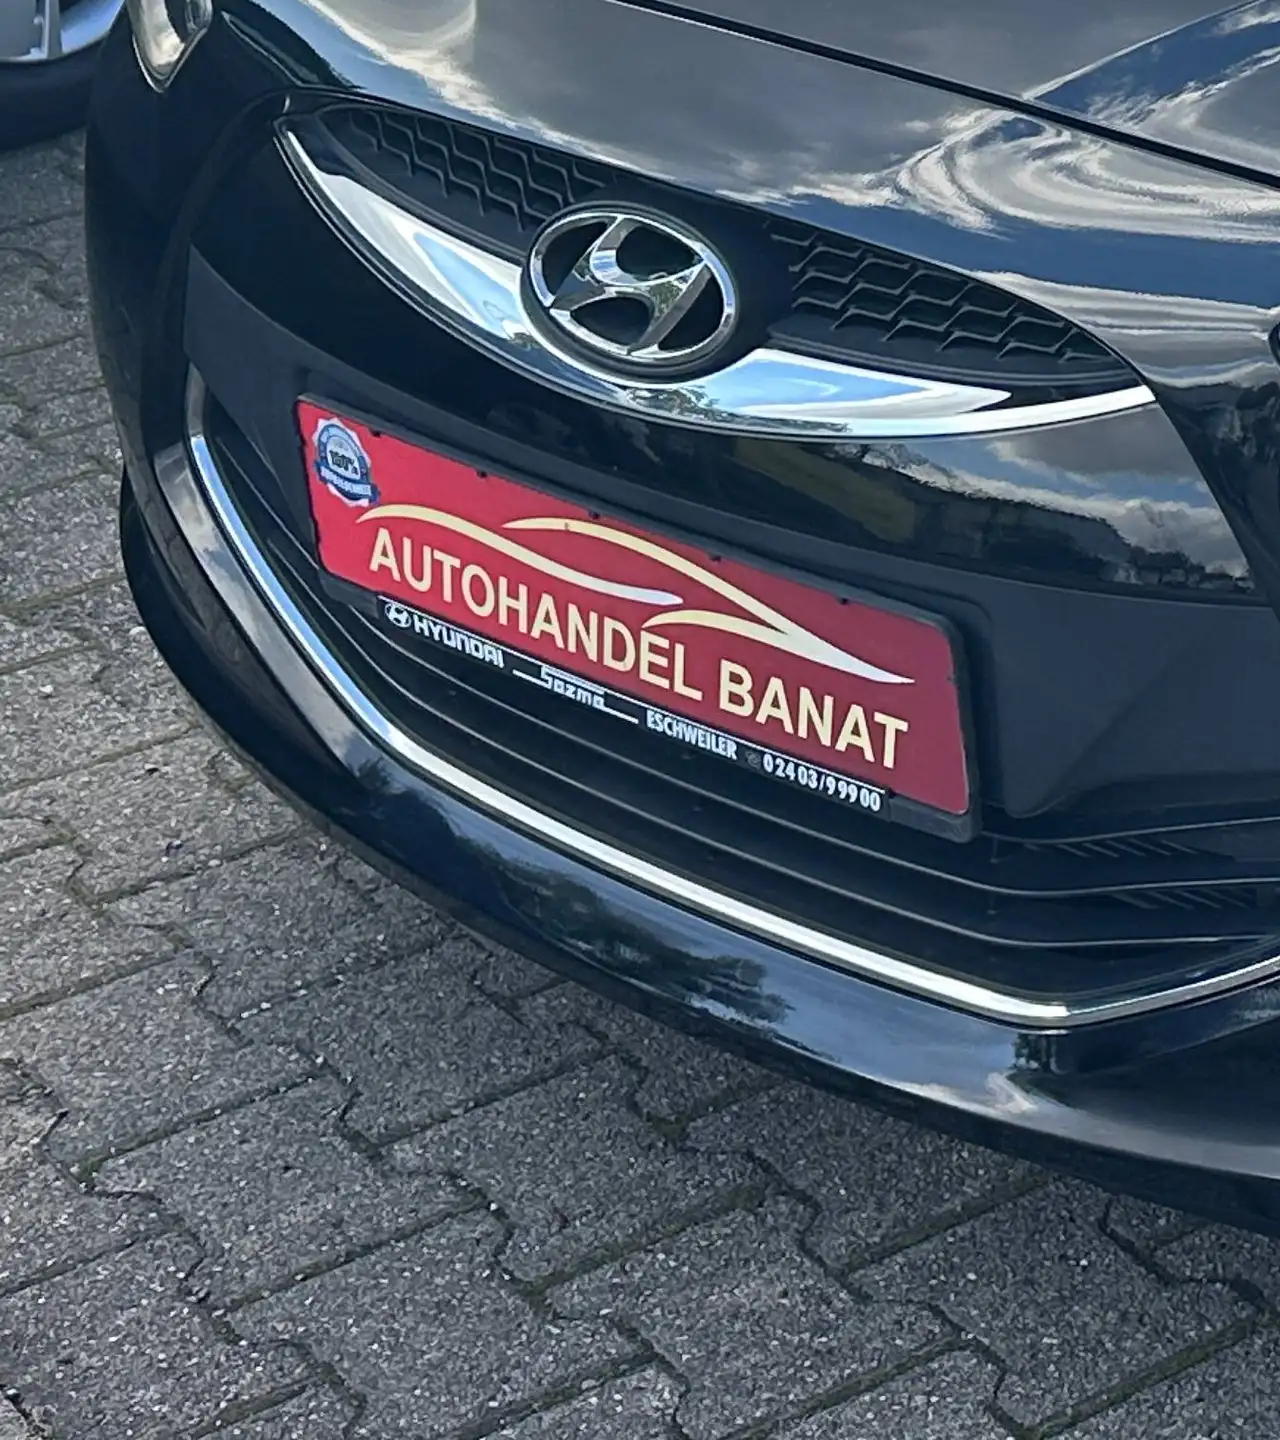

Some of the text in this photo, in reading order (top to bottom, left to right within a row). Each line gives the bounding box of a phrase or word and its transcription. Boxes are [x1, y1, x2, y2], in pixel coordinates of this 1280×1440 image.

[369, 527, 910, 769] AUTOHANDEL BANAT
[412, 613, 505, 669] HYUNDAI
[646, 709, 738, 761] ESCHWEILER
